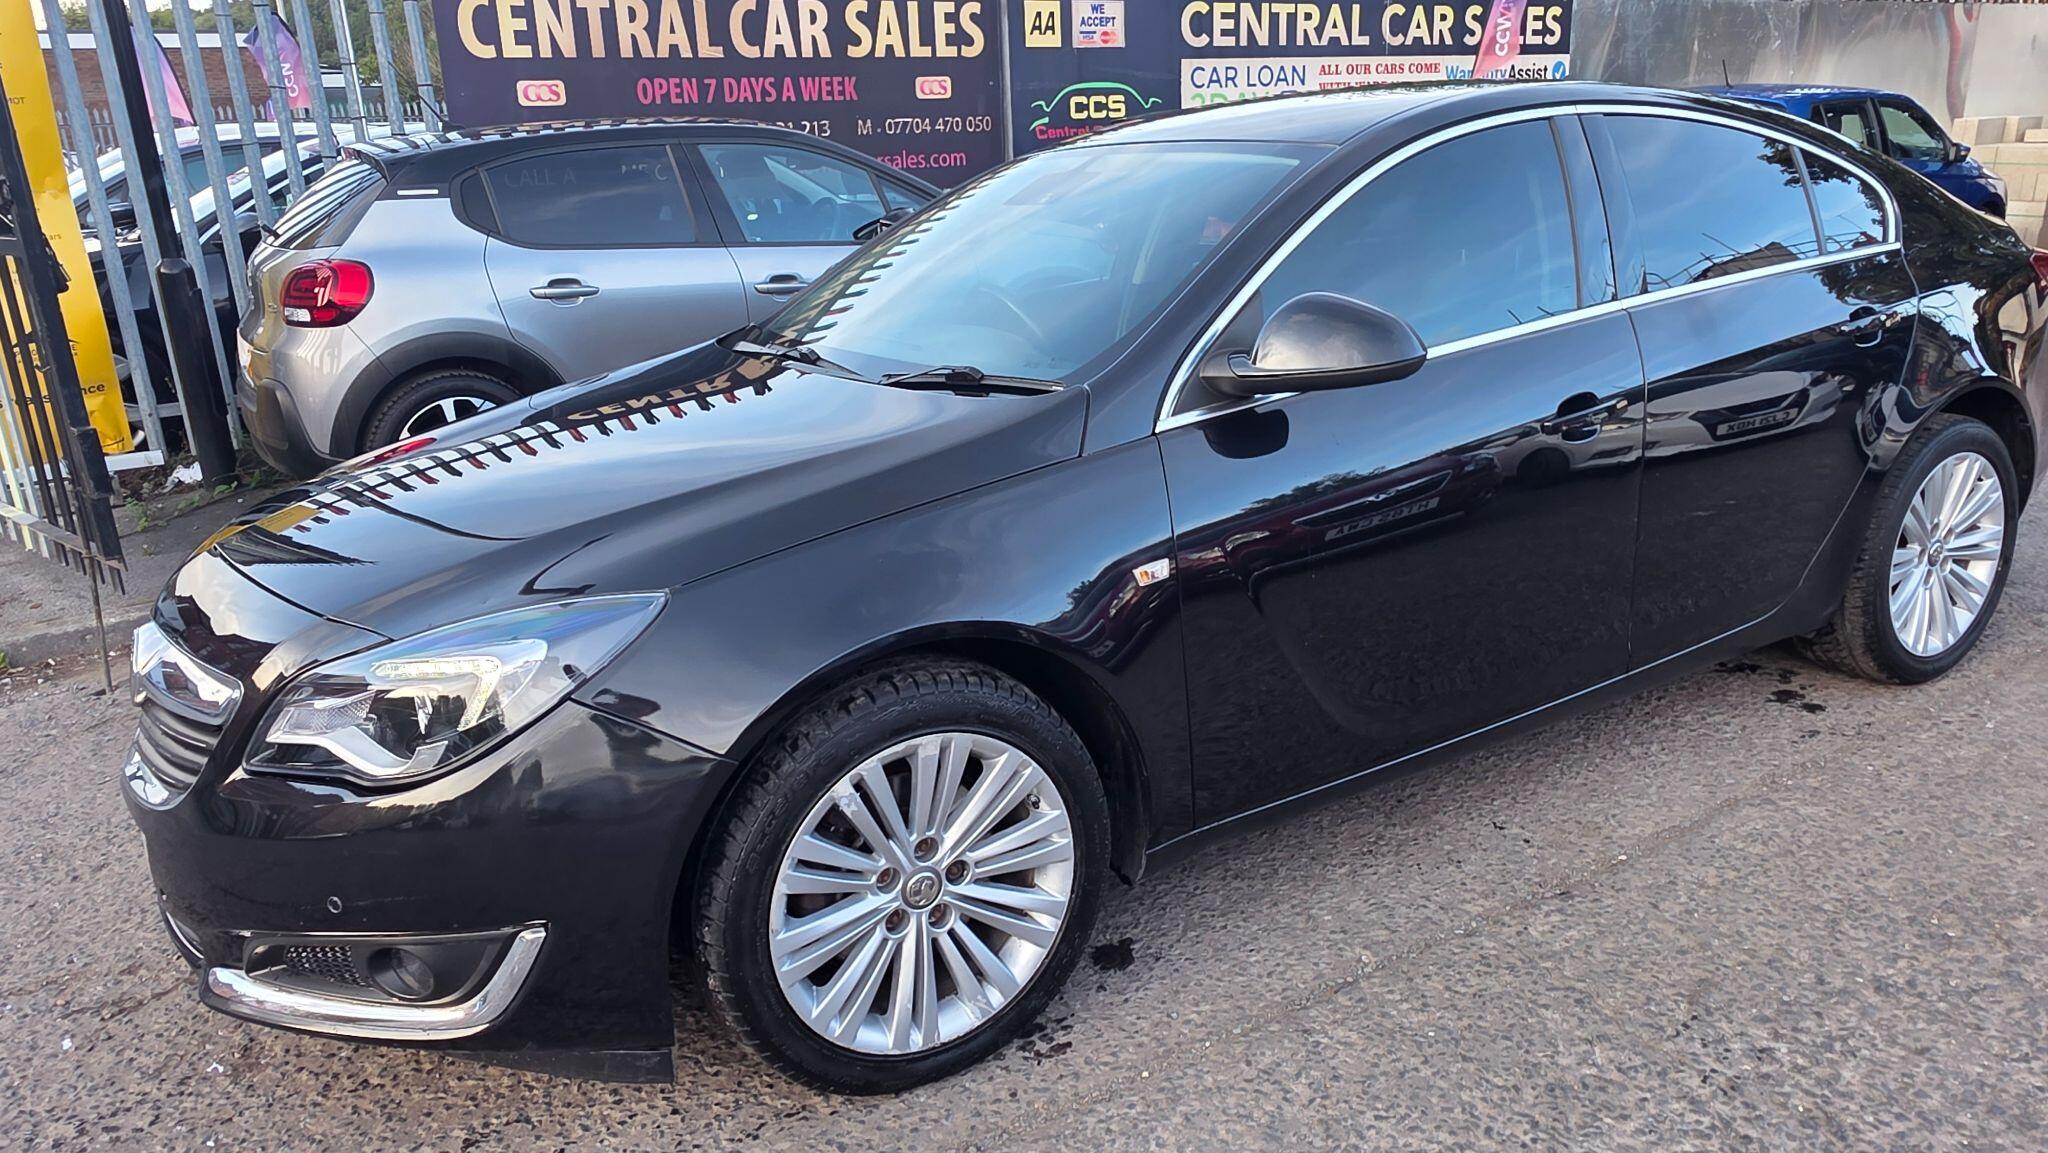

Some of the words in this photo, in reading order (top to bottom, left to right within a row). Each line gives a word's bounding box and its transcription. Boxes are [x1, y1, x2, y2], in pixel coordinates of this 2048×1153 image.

[1090, 3, 1105, 15] WE
[457, 0, 725, 59] CENTRAL
[729, 0, 832, 59] CAR
[844, 0, 985, 58] SALES
[1029, 10, 1056, 36] AA
[1079, 16, 1116, 28] ACCEPT
[1180, 1, 1370, 48] CENTRAL
[1381, 3, 1454, 46] CAR
[1463, 4, 1563, 46] SES
[1190, 66, 1238, 89] CAR
[1246, 64, 1306, 88] LOAN
[1318, 64, 1342, 76] ALL
[1345, 63, 1372, 76] OUR
[1375, 62, 1405, 75] CARS
[1408, 62, 1441, 74] COME
[521, 83, 562, 103] CCS
[636, 77, 699, 105] OPEN
[703, 78, 717, 104] 7
[723, 77, 777, 104] DAYS
[782, 76, 797, 103] A
[799, 75, 859, 102] WEEK
[919, 79, 948, 96] CCS
[1069, 94, 1126, 120] CCS
[857, 119, 872, 136] M
[885, 117, 931, 135] 07704
[935, 117, 961, 133] 470
[966, 116, 992, 132] 050
